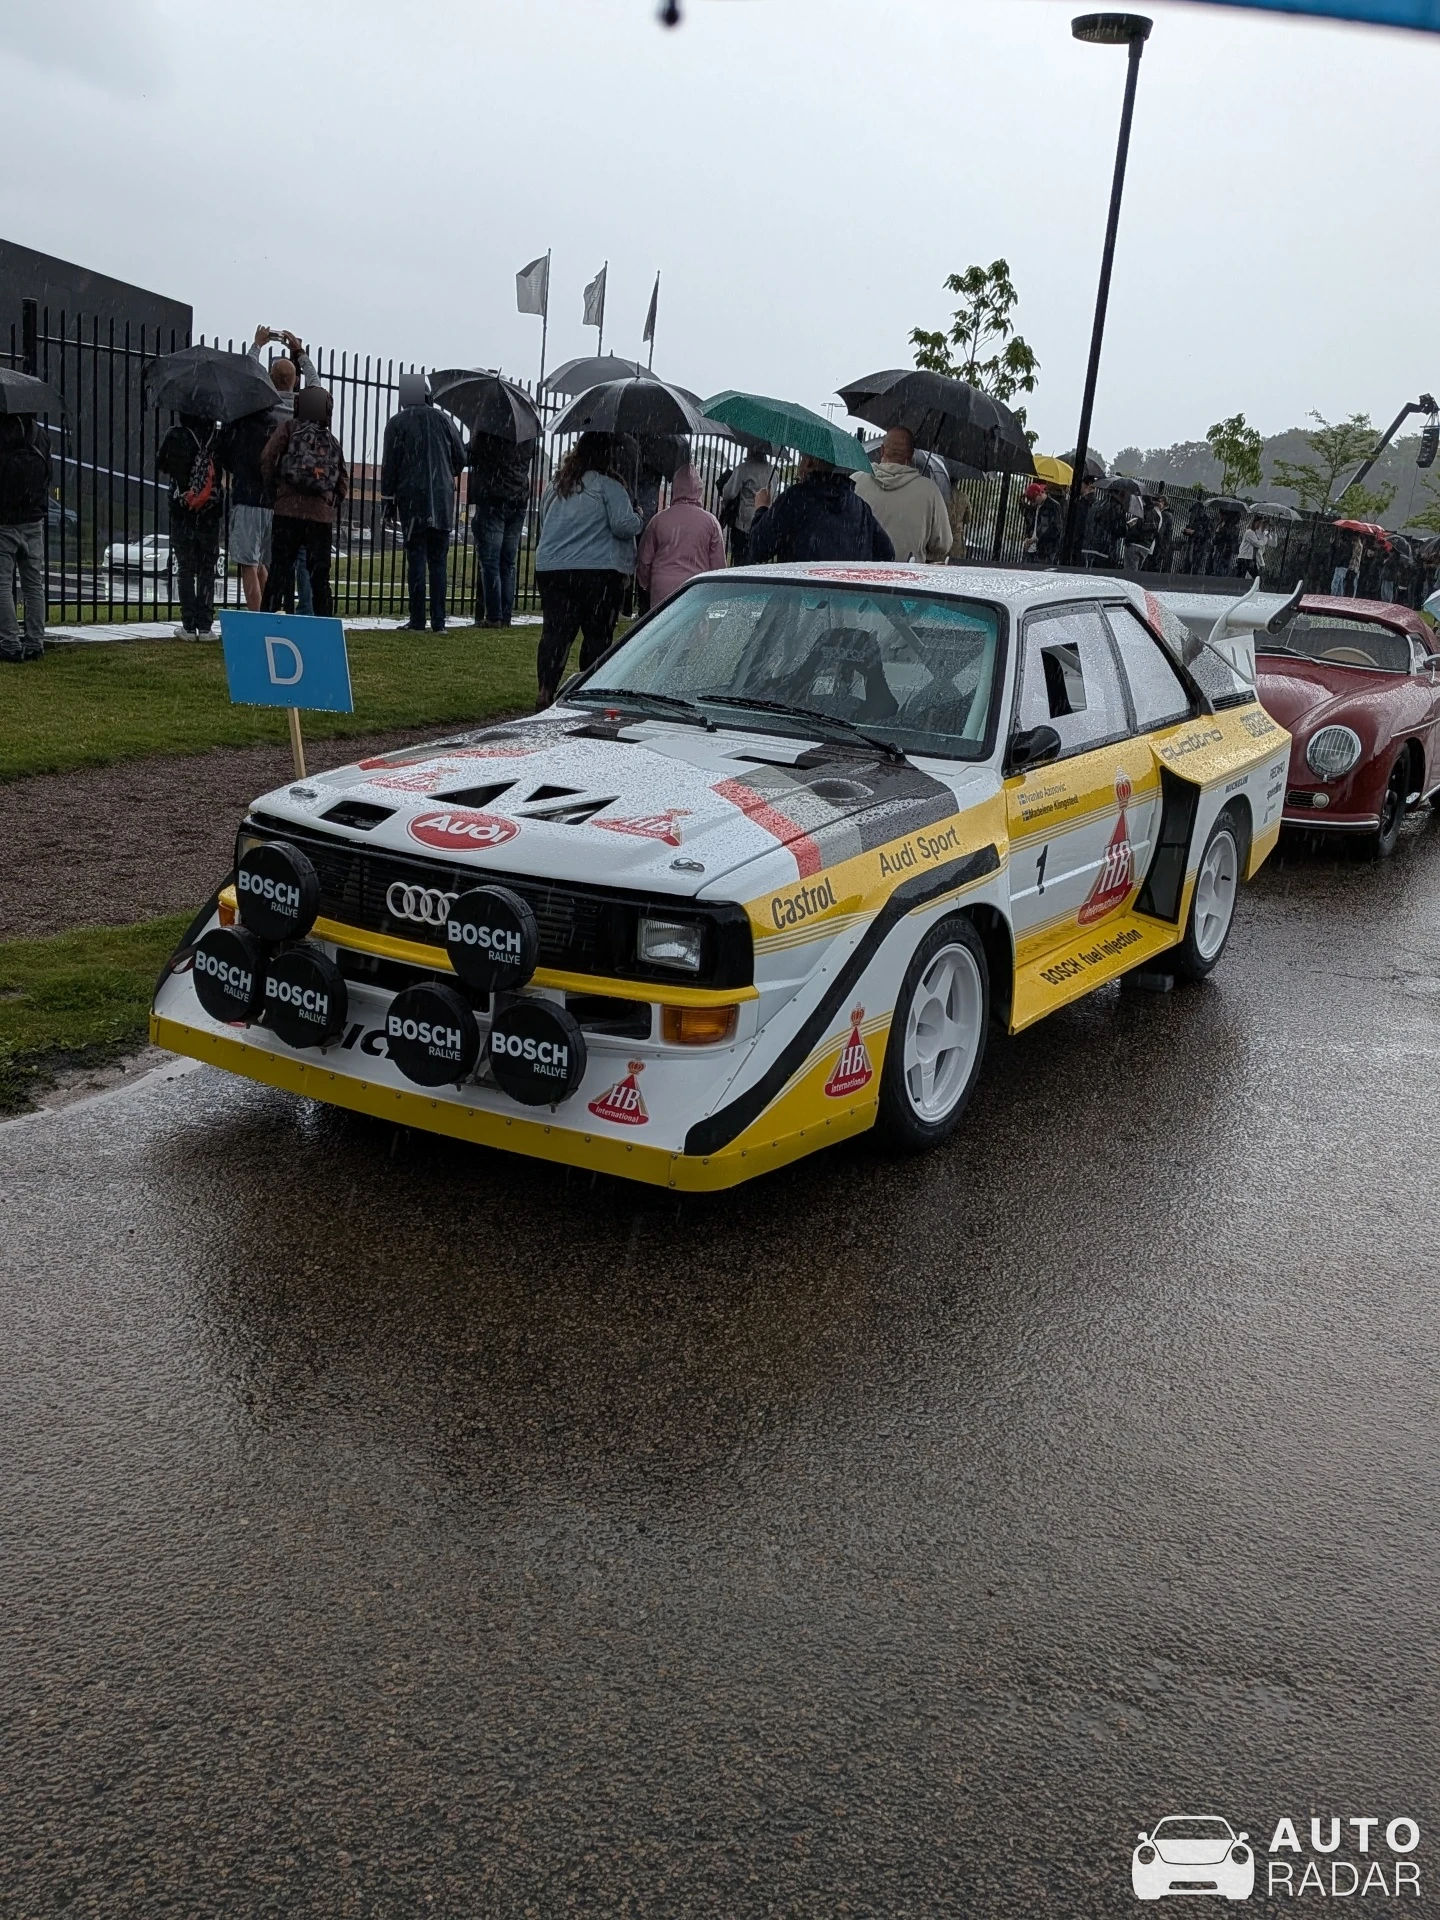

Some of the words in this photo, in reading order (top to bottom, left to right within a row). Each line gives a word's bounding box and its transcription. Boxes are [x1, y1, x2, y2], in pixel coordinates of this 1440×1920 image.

[265, 636, 303, 685] D
[1161, 729, 1223, 761] quattro
[414, 815, 511, 843] Audi
[879, 844, 918, 878] Audi
[919, 825, 961, 863] Sport
[1098, 839, 1132, 896] HB
[1035, 844, 1048, 895] 1
[238, 869, 300, 908] BOSCH
[771, 877, 837, 930] Castrol
[270, 901, 299, 919] RALLYE
[448, 920, 521, 954] BOSCH
[195, 950, 253, 991] BOSCH
[488, 950, 521, 966] RALLYE
[1039, 957, 1086, 986] BOSCH
[1078, 942, 1106, 967] fuel
[1100, 928, 1144, 955] injection
[223, 983, 250, 1004] RALLYE
[265, 976, 329, 1015] BOSCH
[298, 1008, 328, 1027] RALLYE
[388, 1015, 462, 1050] BOSCH
[428, 1045, 462, 1062] RALLYE
[491, 1034, 568, 1068] BOSCH
[838, 1044, 865, 1078] HB
[533, 1062, 568, 1080] RALLYE
[831, 1074, 866, 1094] International
[595, 1105, 640, 1124] International
[606, 1085, 641, 1111] HB
